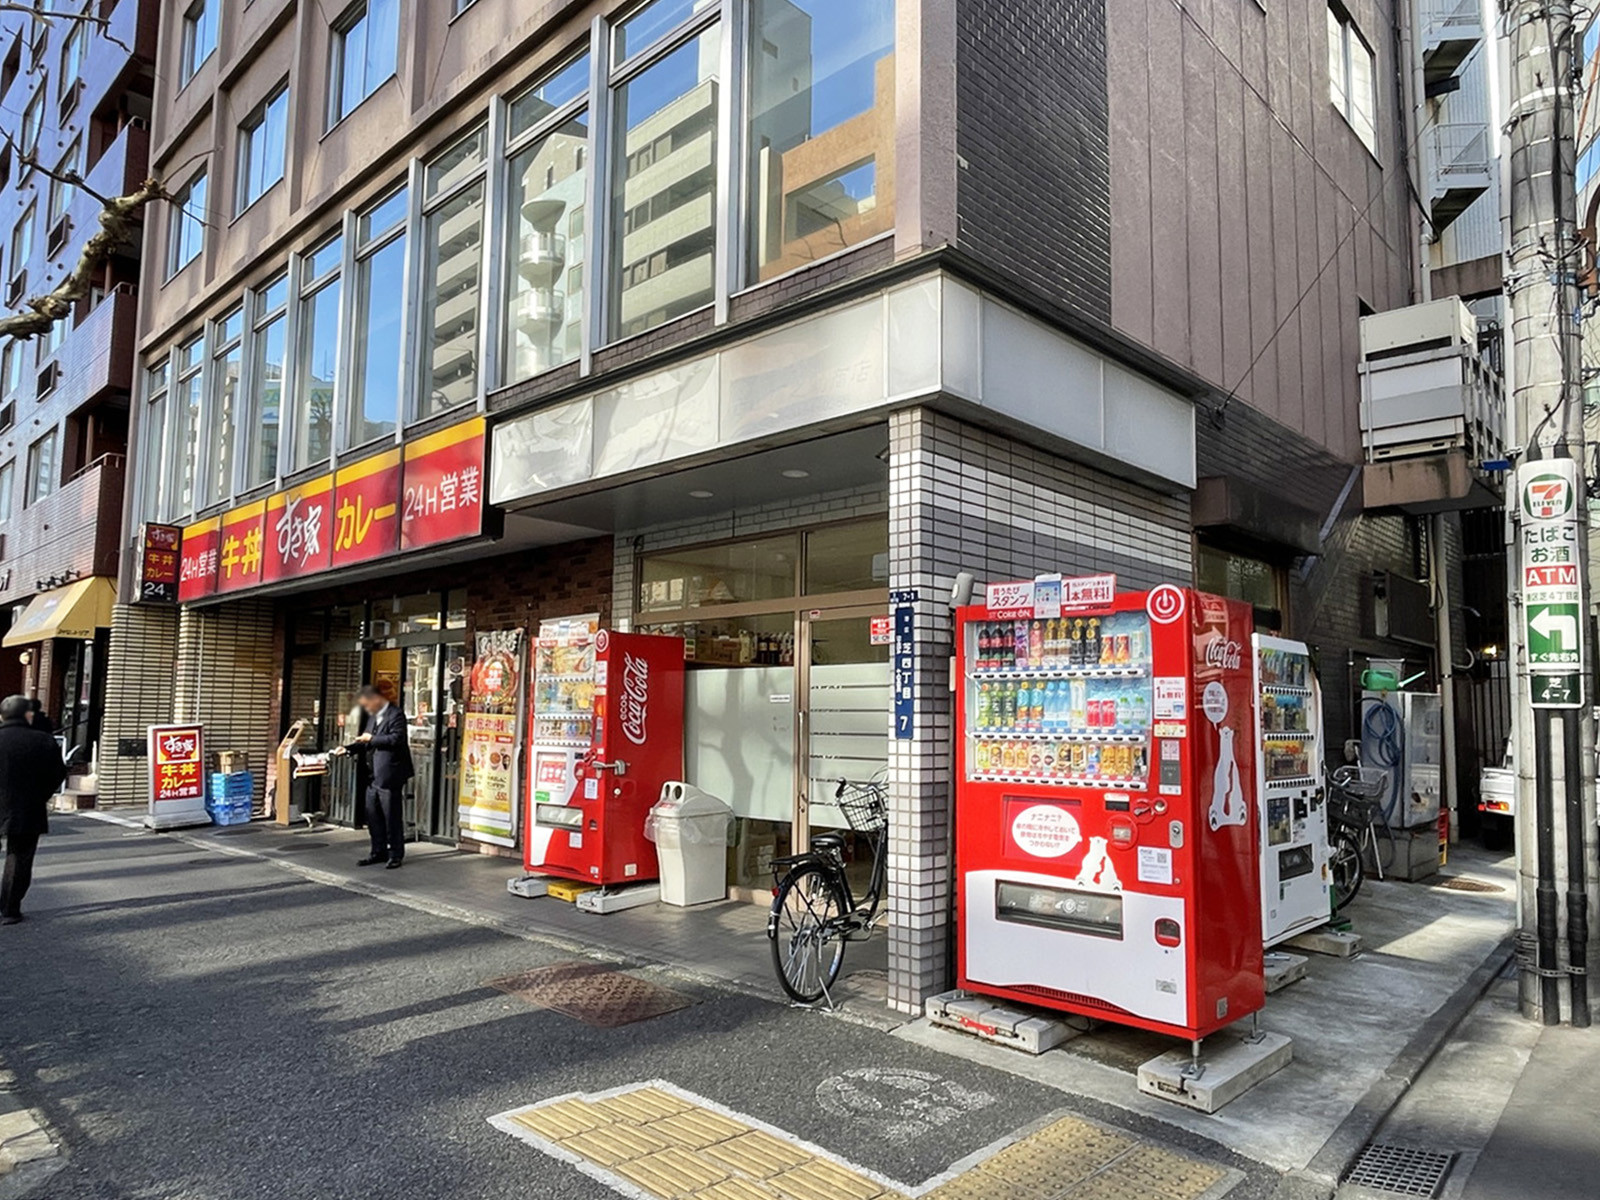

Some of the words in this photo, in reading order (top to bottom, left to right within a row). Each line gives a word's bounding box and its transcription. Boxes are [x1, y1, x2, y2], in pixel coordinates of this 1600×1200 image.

[403, 467, 480, 521] 24H営業
[335, 494, 396, 552] カレー
[276, 494, 323, 569] すき家
[1525, 526, 1575, 545] たばこ
[148, 553, 174, 566] 牛丼
[220, 526, 262, 579] 牛丼
[1531, 546, 1570, 563] お酒
[146, 567, 173, 579] カレー
[180, 549, 218, 581] 24H営業
[1527, 568, 1576, 585] ATM
[144, 581, 165, 595] 24
[992, 586, 1020, 597] 買うたび
[991, 593, 1029, 607] スタンプ
[901, 642, 912, 699] 芝四丁目
[1548, 677, 1562, 688] 芝
[1541, 689, 1571, 701] 4-7
[899, 715, 909, 731] 7
[163, 735, 195, 756] すき家
[161, 763, 196, 776] 牛丼
[161, 776, 197, 789] カレー
[159, 786, 198, 798] 24H営業
